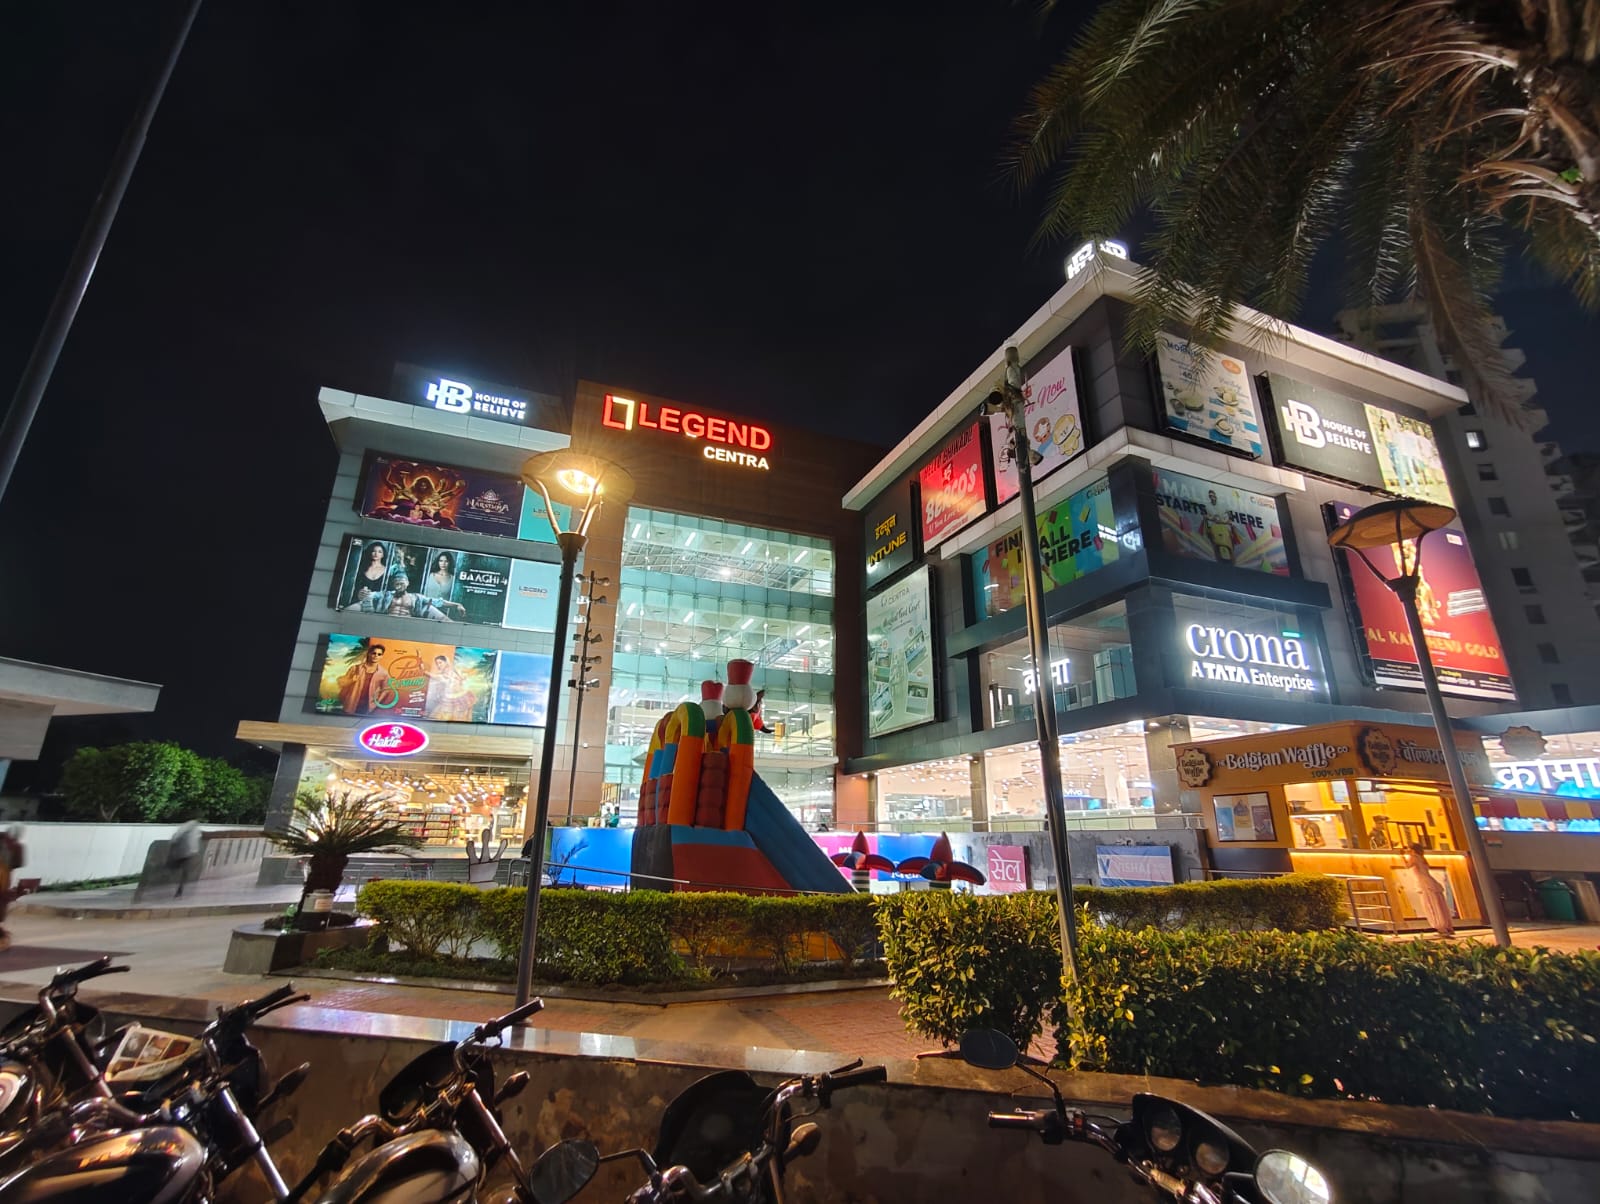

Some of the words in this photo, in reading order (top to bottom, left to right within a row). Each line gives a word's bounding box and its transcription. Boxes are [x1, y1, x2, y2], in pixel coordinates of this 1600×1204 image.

[473, 401, 526, 420] BELIEVE
[474, 392, 511, 407] HOUSE
[511, 400, 527, 410] OF
[637, 402, 770, 450] LEGEND
[1321, 418, 1354, 437] HOUSE
[1354, 428, 1367, 440] OF
[703, 446, 770, 470] CENTRA
[1324, 430, 1372, 455] BELIEVE
[1156, 494, 1208, 516] STARTS
[1228, 510, 1265, 530] HERE
[867, 531, 907, 567] INTUNE
[1040, 526, 1070, 550] ALL
[1044, 530, 1092, 567] HERE
[459, 570, 500, 585] BAAGHI
[1186, 623, 1310, 671] croma
[1367, 628, 1387, 642] AL
[1464, 642, 1500, 659] GOLD
[1191, 660, 1205, 678] A
[1203, 662, 1250, 684] TATA
[1249, 668, 1315, 693] Enterprise
[1226, 751, 1281, 773] Belgian
[1281, 742, 1337, 769] Waffle
[987, 850, 1022, 882] सेल
